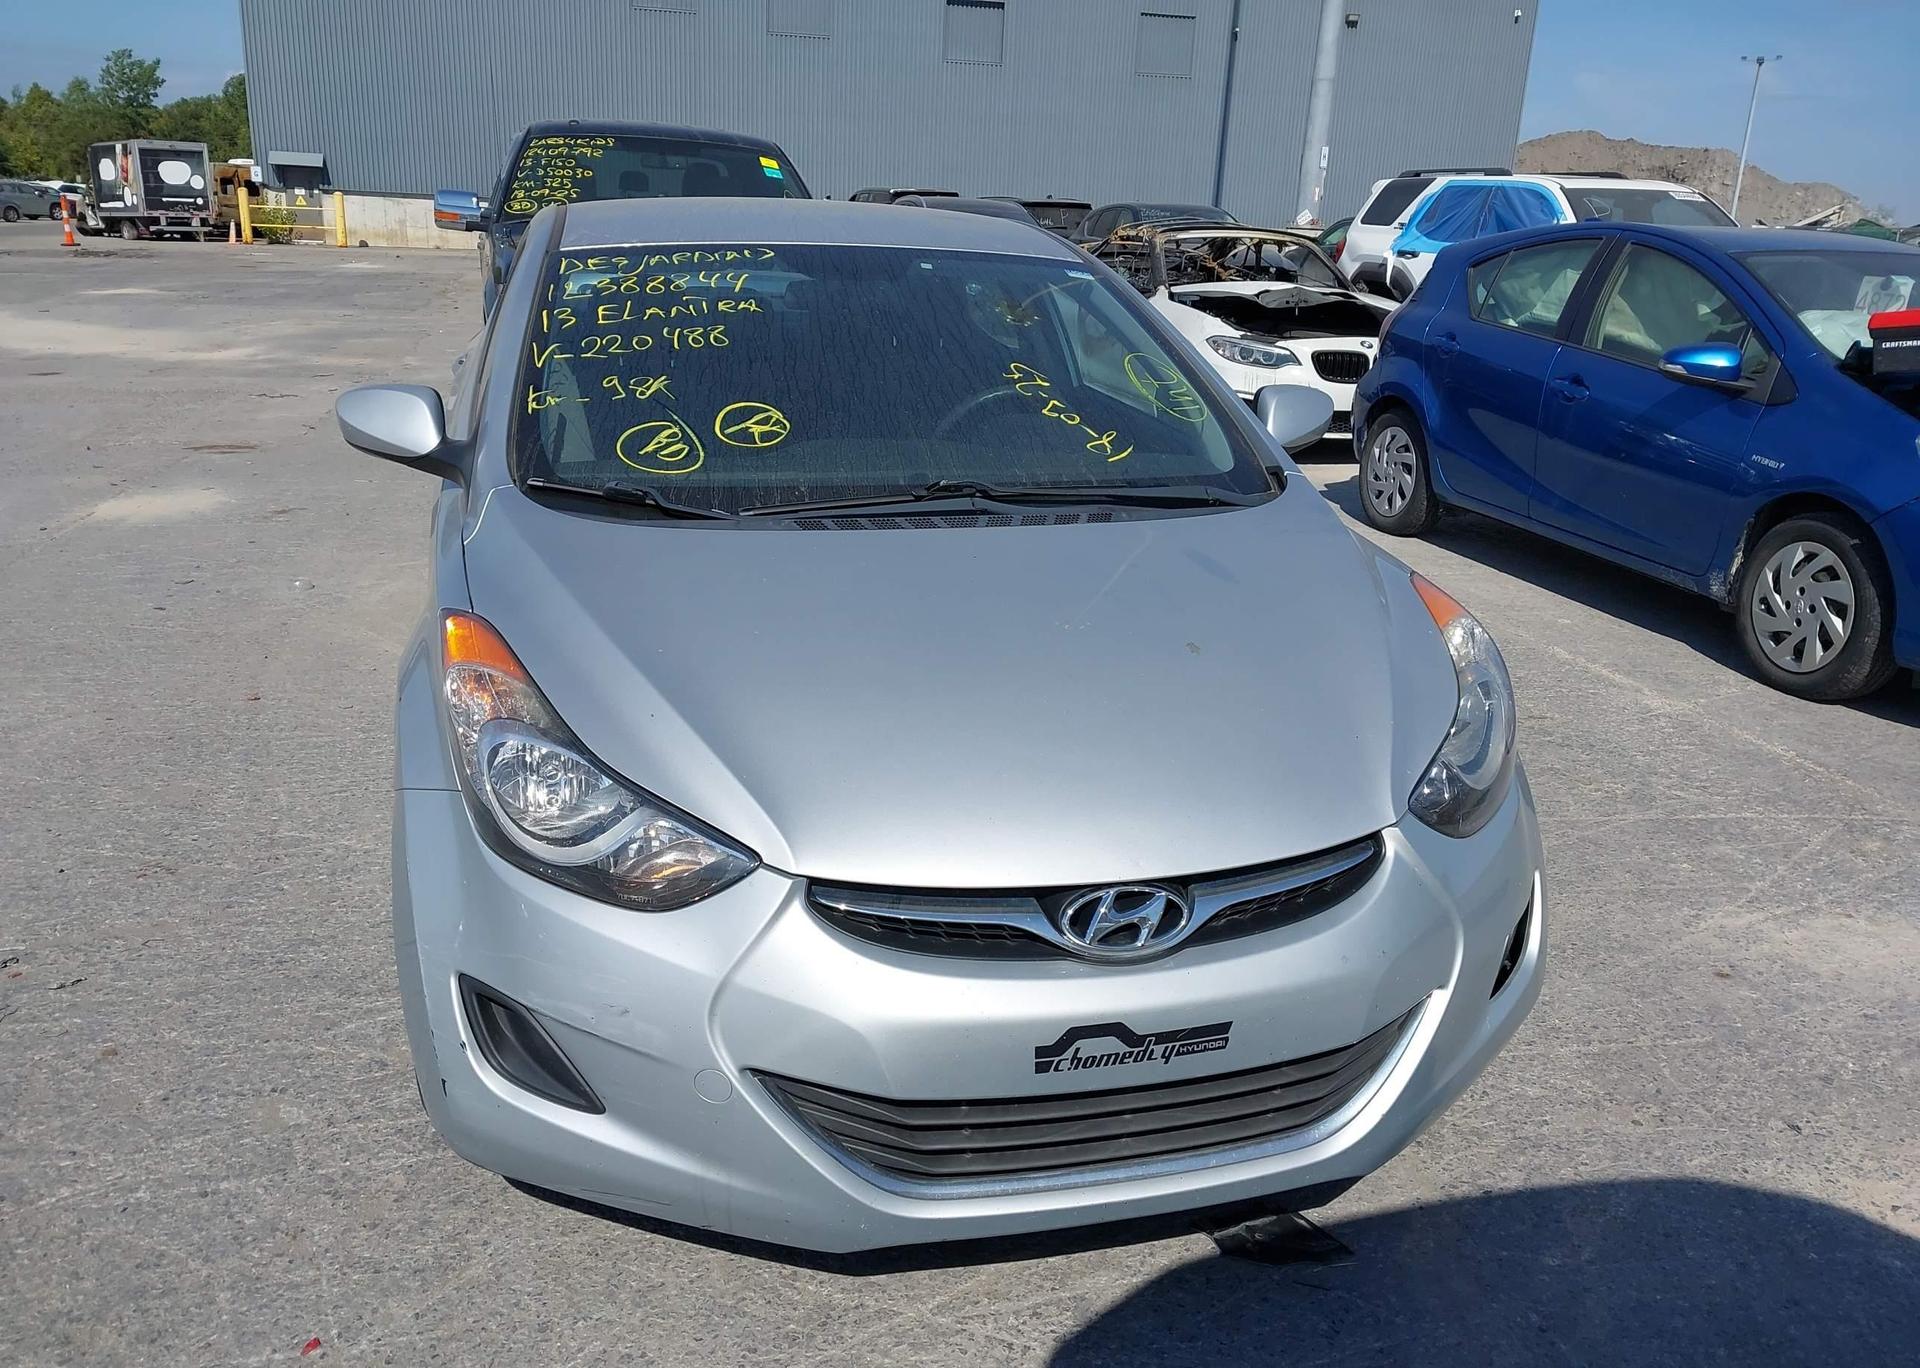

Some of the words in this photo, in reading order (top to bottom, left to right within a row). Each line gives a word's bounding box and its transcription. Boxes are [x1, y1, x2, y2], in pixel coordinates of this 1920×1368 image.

[542, 308, 576, 332] 13
[597, 296, 764, 324] ELANTRA
[1180, 1040, 1226, 1053] HYUNDAI
